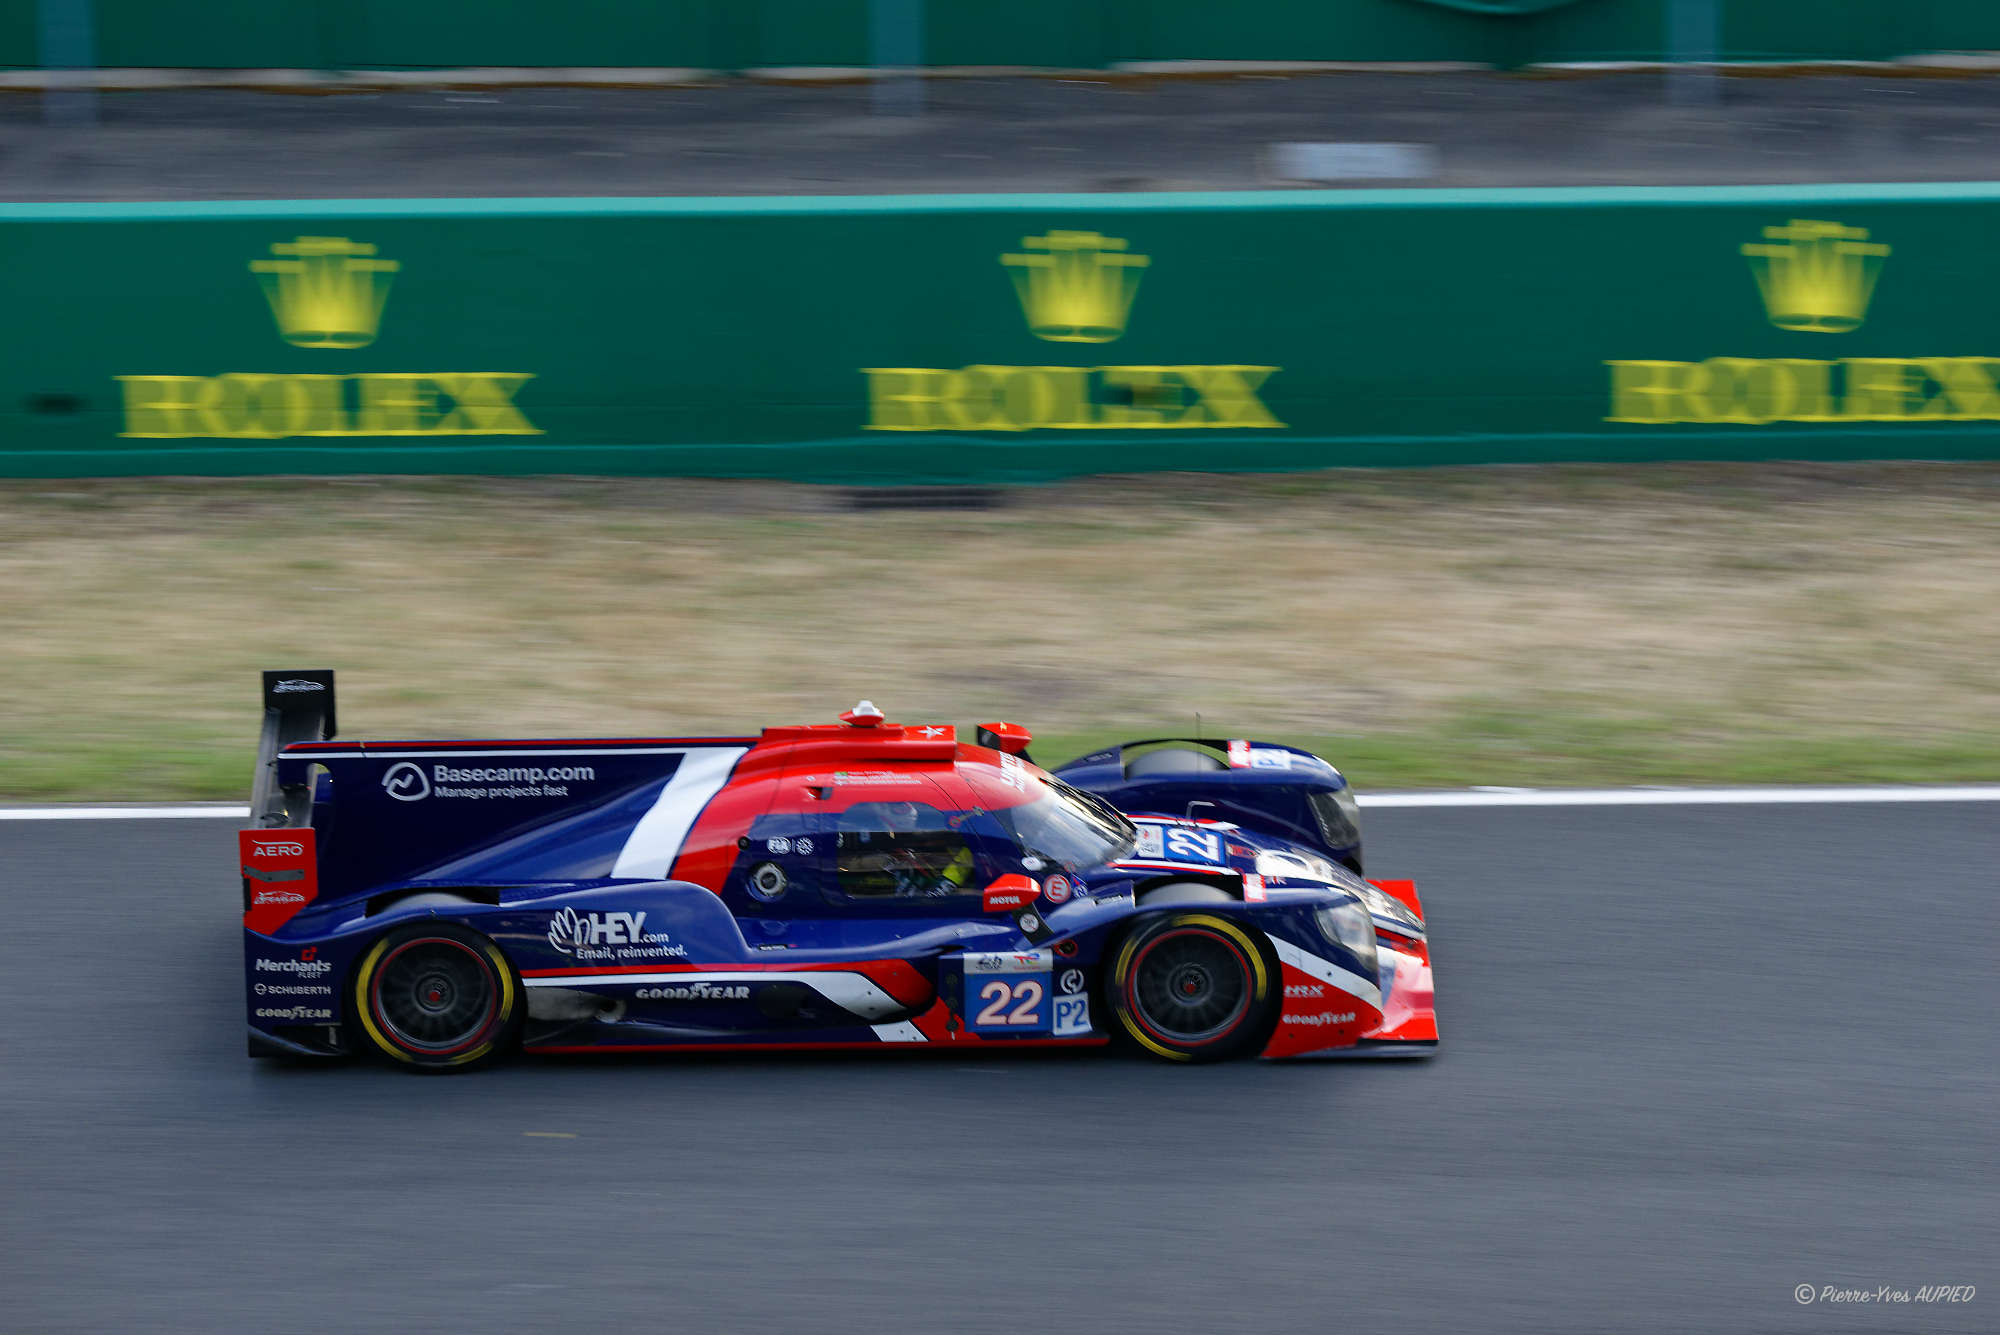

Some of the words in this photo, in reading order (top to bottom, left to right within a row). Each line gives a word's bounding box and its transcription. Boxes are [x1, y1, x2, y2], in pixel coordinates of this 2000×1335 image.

[113, 371, 546, 438] ROLEX
[860, 365, 1288, 431] ROLEX
[433, 764, 595, 785] Basecamp.com
[434, 786, 488, 799] Manage
[488, 785, 542, 799] projects
[543, 784, 569, 797] fast
[253, 846, 303, 857] AERO
[1167, 827, 1220, 862] 22
[989, 895, 1021, 905] MOTUL
[576, 946, 615, 960] Email,
[617, 944, 688, 959] reinvented.
[255, 958, 332, 972] Merchants
[268, 985, 332, 996] SCHUBERTH
[634, 982, 750, 1000] GOODYEAR
[975, 981, 1043, 1026] 22
[255, 1006, 332, 1020] GOODYEAR
[1056, 1000, 1088, 1030] P2
[1282, 1011, 1356, 1027] GOODYEAR
